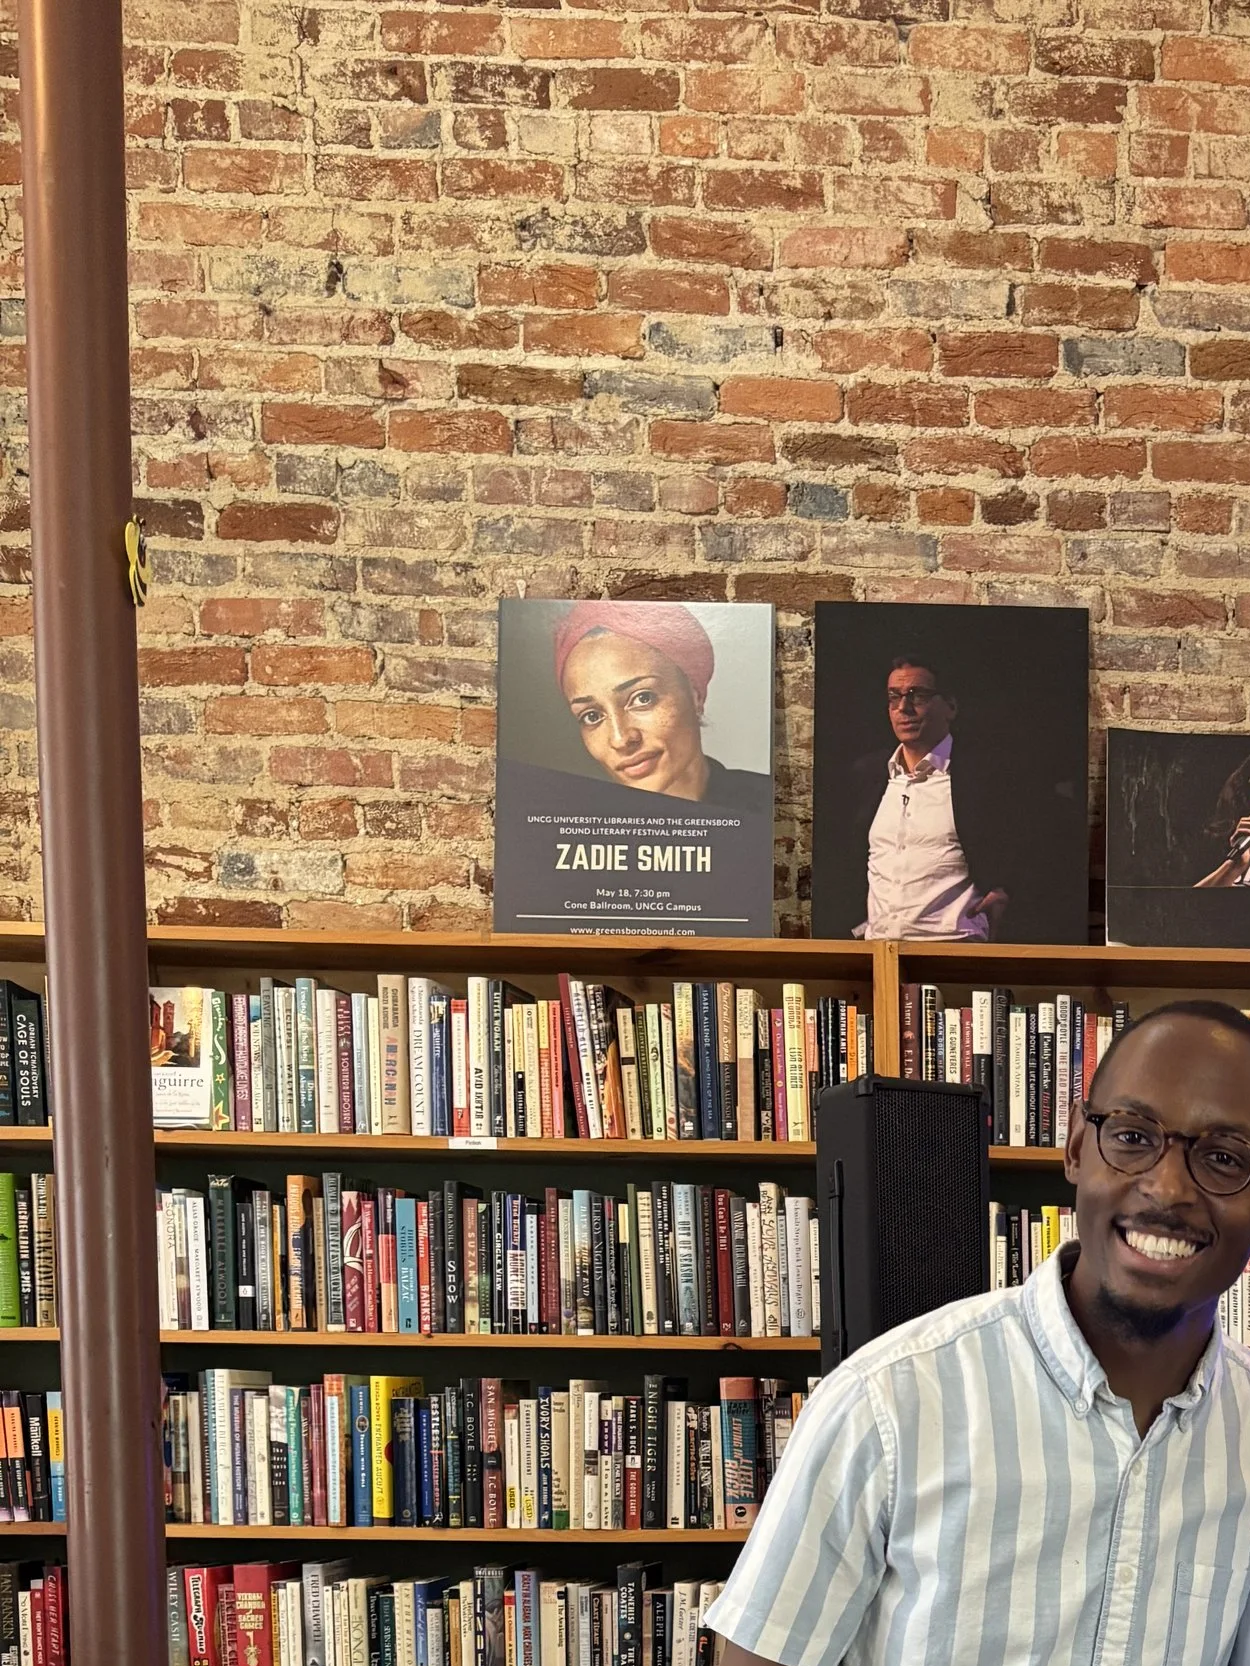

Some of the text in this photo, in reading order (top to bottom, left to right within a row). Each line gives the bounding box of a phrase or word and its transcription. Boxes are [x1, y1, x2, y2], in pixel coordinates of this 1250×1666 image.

[554, 816, 602, 824] UNIVERSITY
[604, 817, 645, 825] LIBRARIES
[667, 818, 683, 826] THE
[684, 818, 740, 827] GREENSBORO
[592, 828, 631, 836] LITERARY
[633, 828, 670, 836] FESTIVAL
[672, 829, 708, 837] PRESENT
[555, 843, 712, 873] ZADIE SMITH
[564, 901, 588, 910] Cone
[635, 902, 664, 911] UNCG
[666, 902, 702, 913] Campus
[596, 888, 670, 900] May 18, 7:30 pm
[570, 926, 696, 936] www.greensborobound.com
[722, 986, 732, 1061] Portrait in Sepia
[996, 995, 1007, 1066] Cloud Chamber
[17, 1014, 31, 1106] CAGE OF SOULS
[28, 1022, 39, 1098] ADRIAN TCHAIKOVSKY
[413, 1029, 425, 1116] DREAM COUNT
[1060, 1001, 1068, 1127] RODDY DOYLE THE DEAD REPUBLIC
[166, 1201, 176, 1249] SONORA
[766, 1196, 774, 1214] ANN
[291, 1185, 303, 1309] ANXIOUS PEOPLE FREDRIK BACKMAN
[593, 1202, 603, 1281] ELROY NIGHTS
[678, 1220, 693, 1284] OUT OF SEASON
[37, 1228, 54, 1302] TAKEOVER
[447, 1260, 458, 1304] Snow
[468, 1232, 476, 1297] SUZANNE
[762, 1220, 779, 1307] LOVE ALWAYS
[401, 1267, 410, 1303] BALZAC
[421, 1285, 430, 1321] BANKS
[29, 1417, 42, 1457] Mankell
[431, 1396, 440, 1448] RESTLESS
[467, 1416, 475, 1452] BOYLE
[488, 1408, 496, 1444] MIGUEL
[647, 1391, 658, 1472] NIGHT TIGER
[732, 1418, 743, 1459] LIVING IN
[489, 1476, 497, 1489] T.C.
[700, 1440, 711, 1487] EVELINA
[725, 1459, 739, 1499] ROCK
[740, 1458, 754, 1498] LITTLE
[489, 1493, 497, 1523] BOYLE
[0, 1574, 15, 1640] IAN RANKIN
[48, 1575, 60, 1656] CROSS HER HEART
[168, 1572, 180, 1642] WILEY CASH
[311, 1574, 321, 1642] FRED CHAPPELL
[370, 1596, 378, 1613] Bruce
[620, 1587, 628, 1619] COATES
[656, 1602, 664, 1637] ALEPH
[371, 1614, 379, 1639] Chatwin
